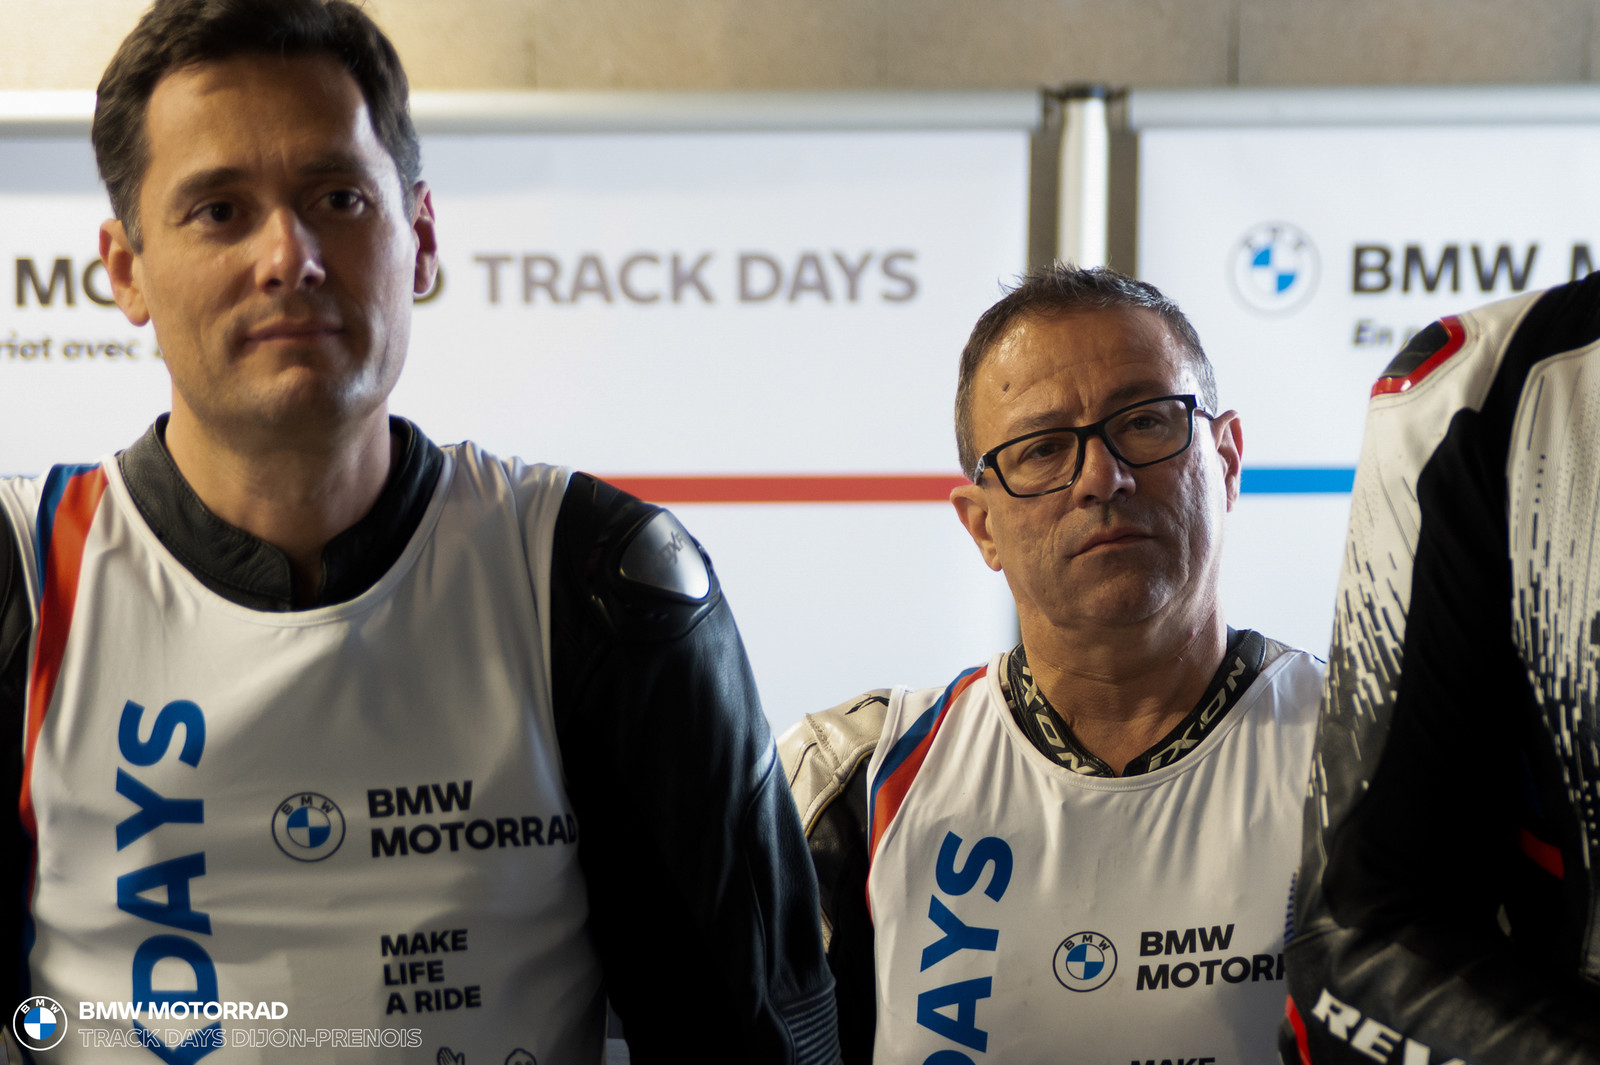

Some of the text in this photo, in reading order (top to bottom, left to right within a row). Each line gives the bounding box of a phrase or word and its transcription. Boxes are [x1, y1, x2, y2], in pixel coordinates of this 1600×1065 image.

[473, 250, 716, 304] TRACK
[735, 250, 921, 304] DAYS
[1351, 244, 1539, 295] BMW
[61, 340, 140, 360] avec
[367, 780, 473, 819] BMW
[371, 812, 578, 858] MOTORRAD
[116, 699, 220, 1014] DAYS
[381, 928, 468, 957] MAKE
[916, 830, 1014, 1065] AYS
[1139, 923, 1235, 957] BMW
[383, 960, 445, 986] LIFE
[386, 985, 482, 1015] A RIDE
